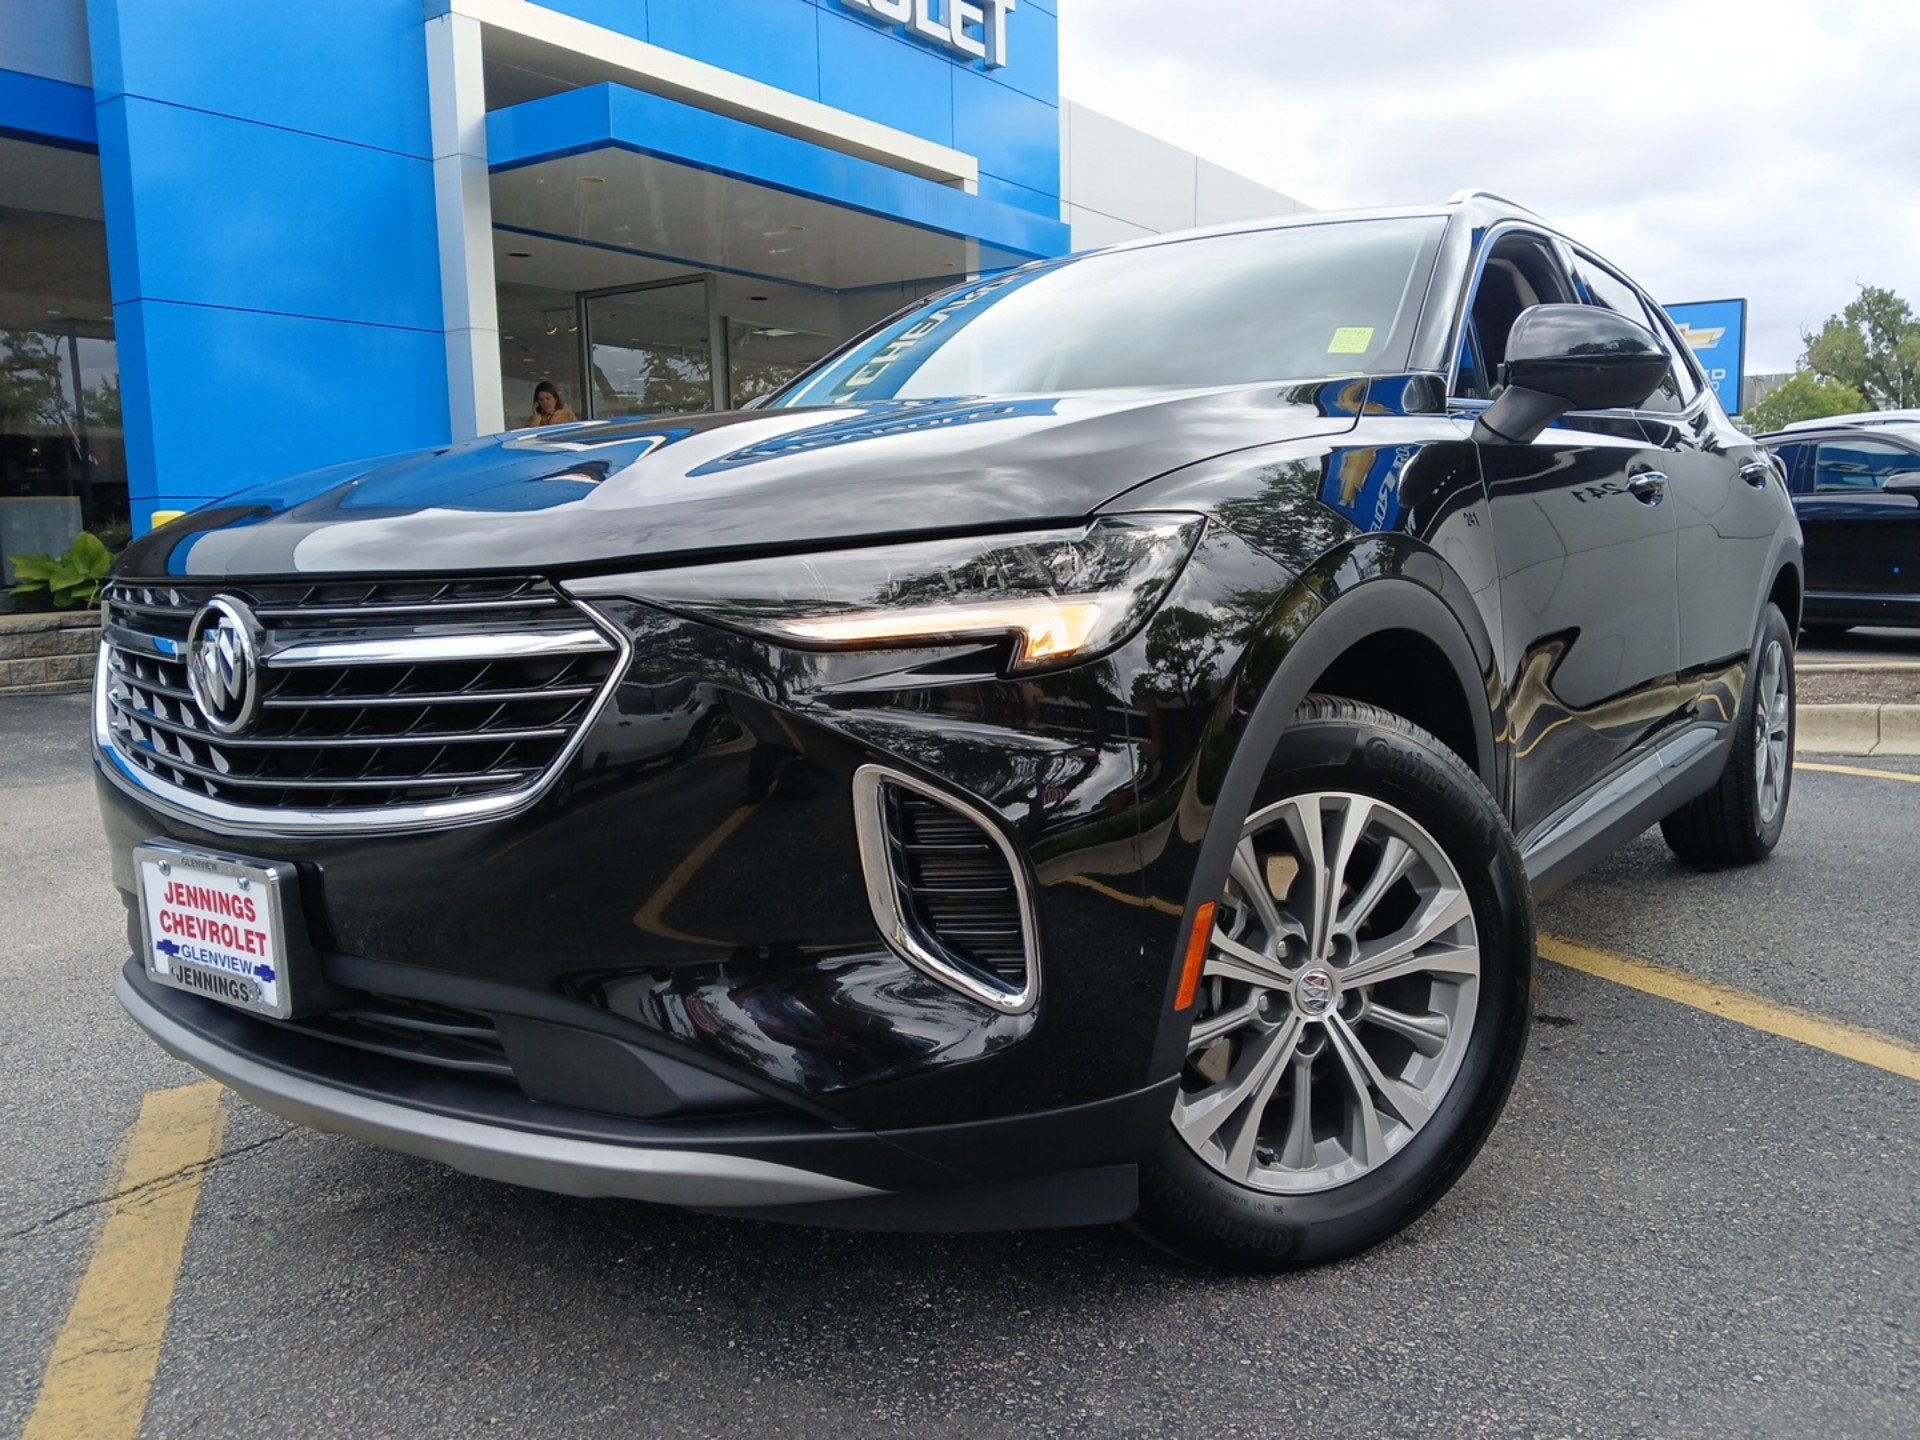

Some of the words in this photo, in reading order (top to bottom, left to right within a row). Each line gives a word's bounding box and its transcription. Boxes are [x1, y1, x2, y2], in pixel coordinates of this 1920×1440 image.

[164, 881, 256, 922] JENNINGS
[159, 909, 267, 957] CHEVROLET
[181, 944, 252, 974] GLENVIEW
[175, 965, 249, 1002] JENNINGS
